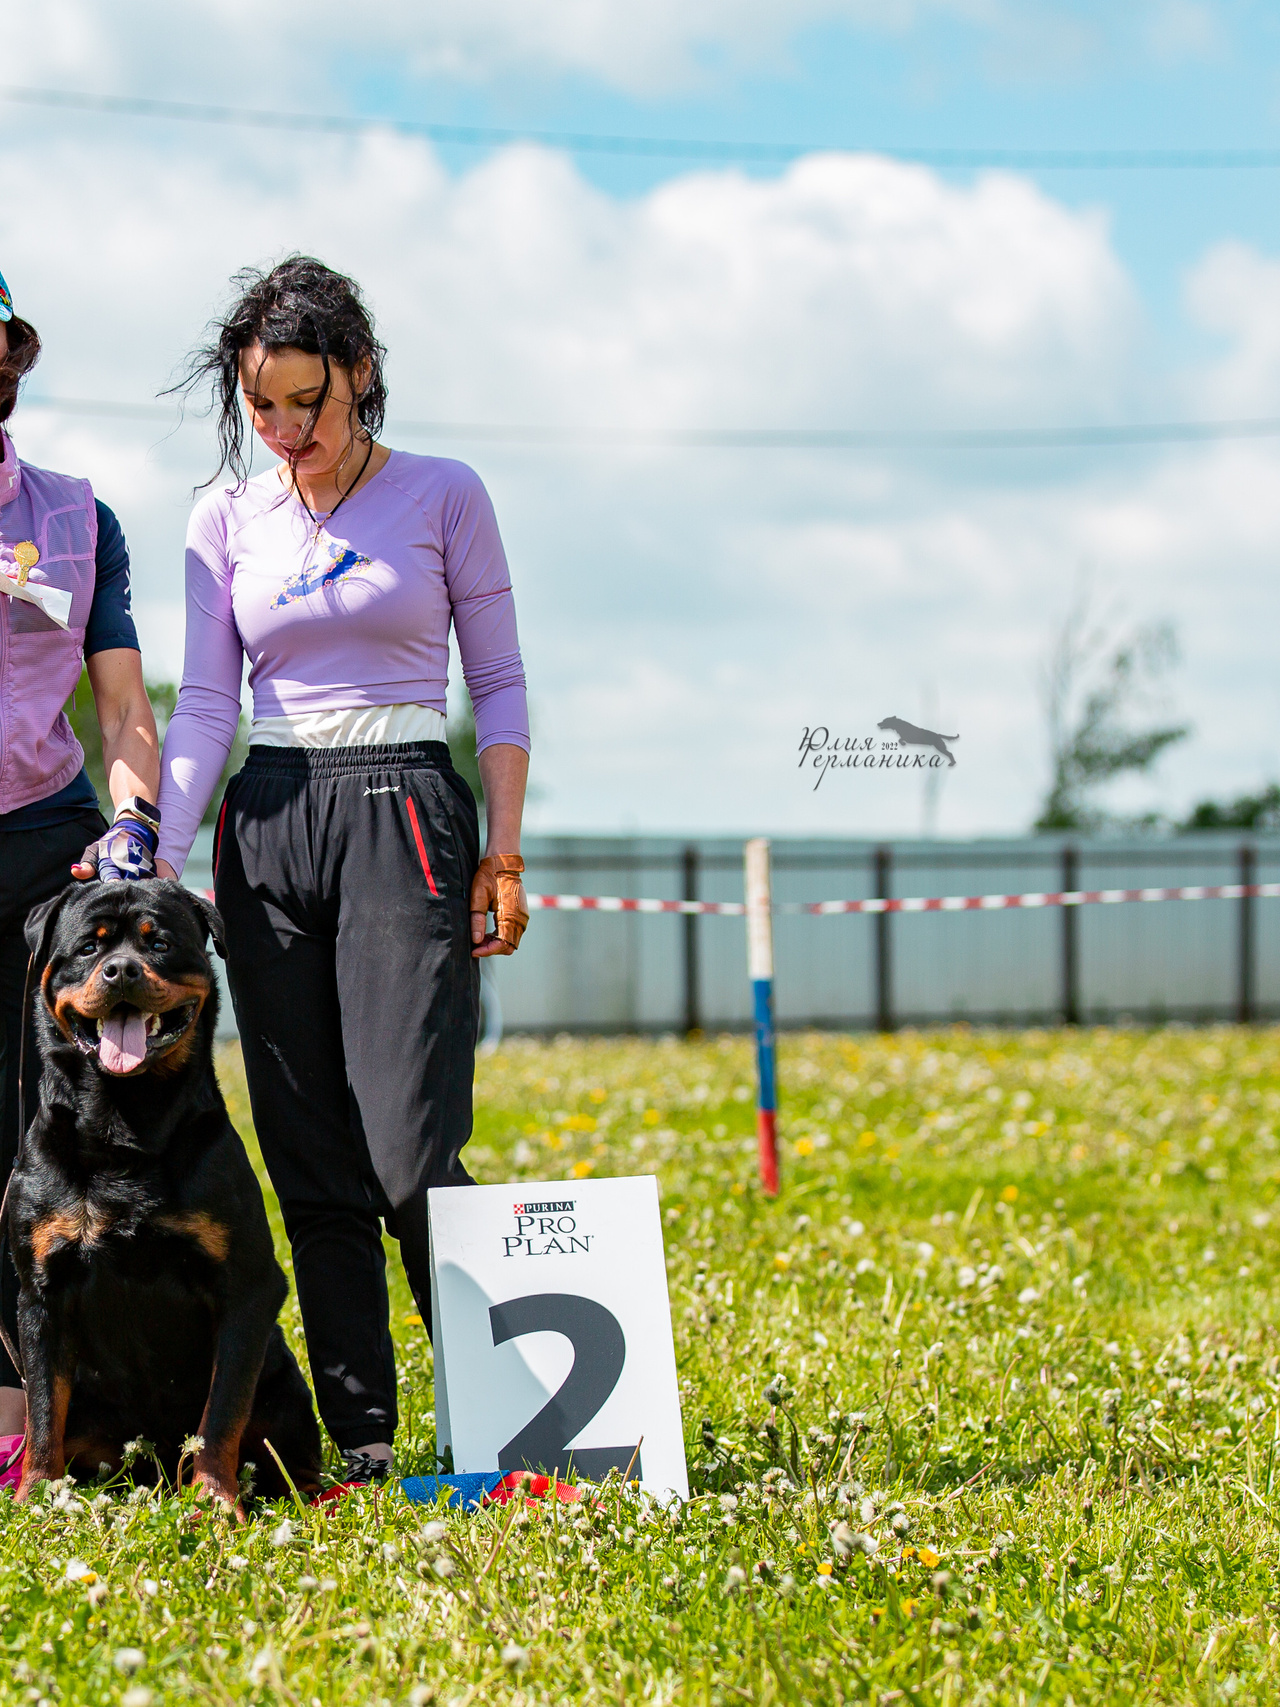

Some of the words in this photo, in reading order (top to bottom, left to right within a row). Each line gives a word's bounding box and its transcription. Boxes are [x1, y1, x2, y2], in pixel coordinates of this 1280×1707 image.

[525, 1202, 573, 1213] PURINA
[513, 1215, 577, 1237] PRO
[501, 1235, 591, 1258] PLAN
[488, 1292, 644, 1482] 2
